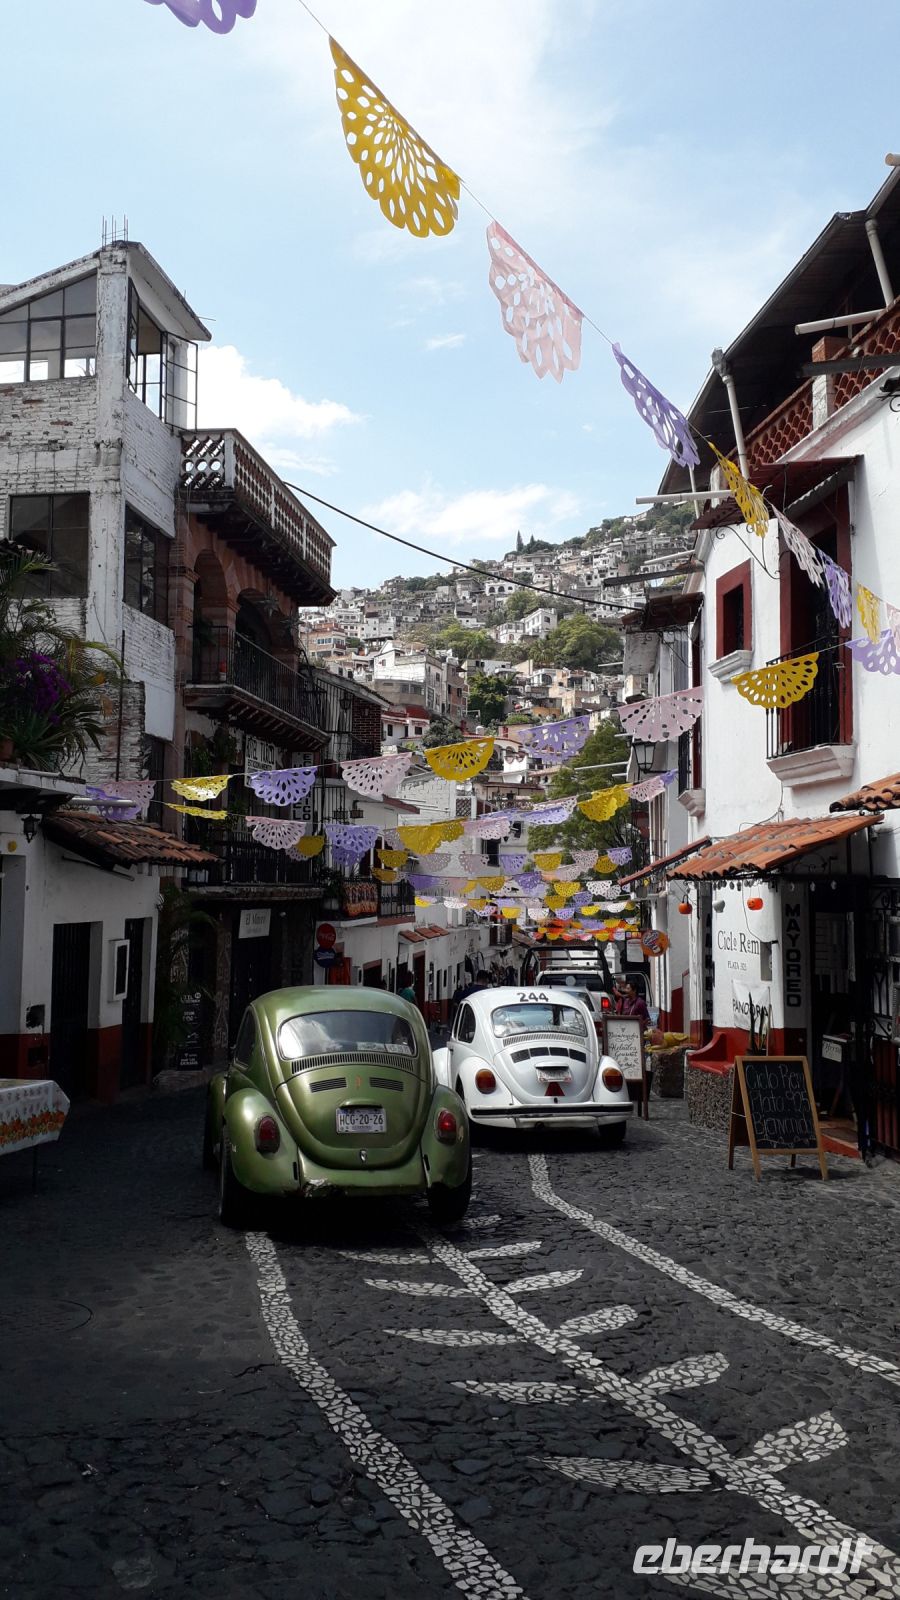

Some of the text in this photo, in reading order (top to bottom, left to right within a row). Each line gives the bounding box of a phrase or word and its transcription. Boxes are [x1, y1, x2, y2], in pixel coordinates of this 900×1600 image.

[717, 930, 760, 955] Ciclo Rem
[785, 903, 802, 1007] MAYOREO
[516, 992, 550, 1003] 244
[339, 1113, 384, 1126] HCG-20-26
